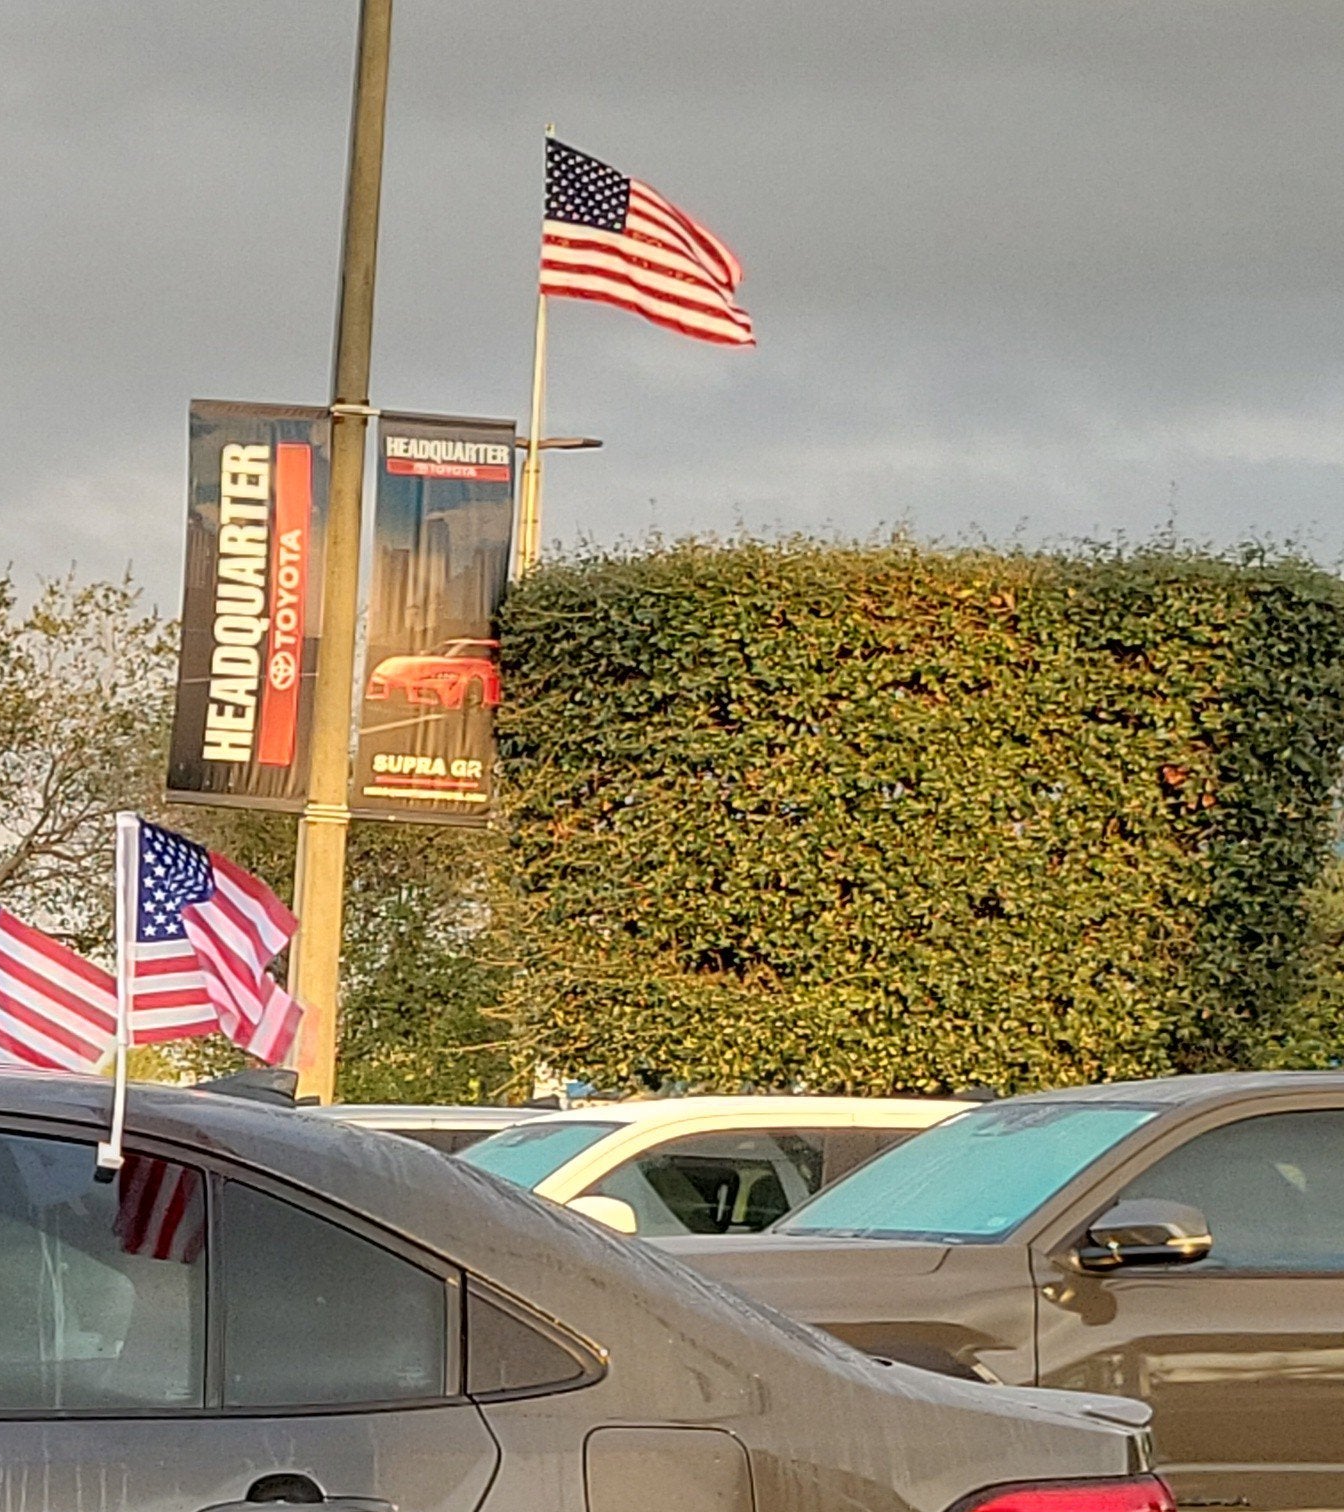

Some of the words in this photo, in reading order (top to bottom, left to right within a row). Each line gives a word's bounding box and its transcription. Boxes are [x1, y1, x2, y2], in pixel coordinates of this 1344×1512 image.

[386, 436, 509, 465] HEADQUARTER
[430, 462, 477, 478] TOYOTA
[203, 443, 270, 762] HEADQUARTER
[274, 529, 302, 647] TOYOTA
[373, 754, 446, 776] SUPRA
[450, 759, 482, 778] GR
